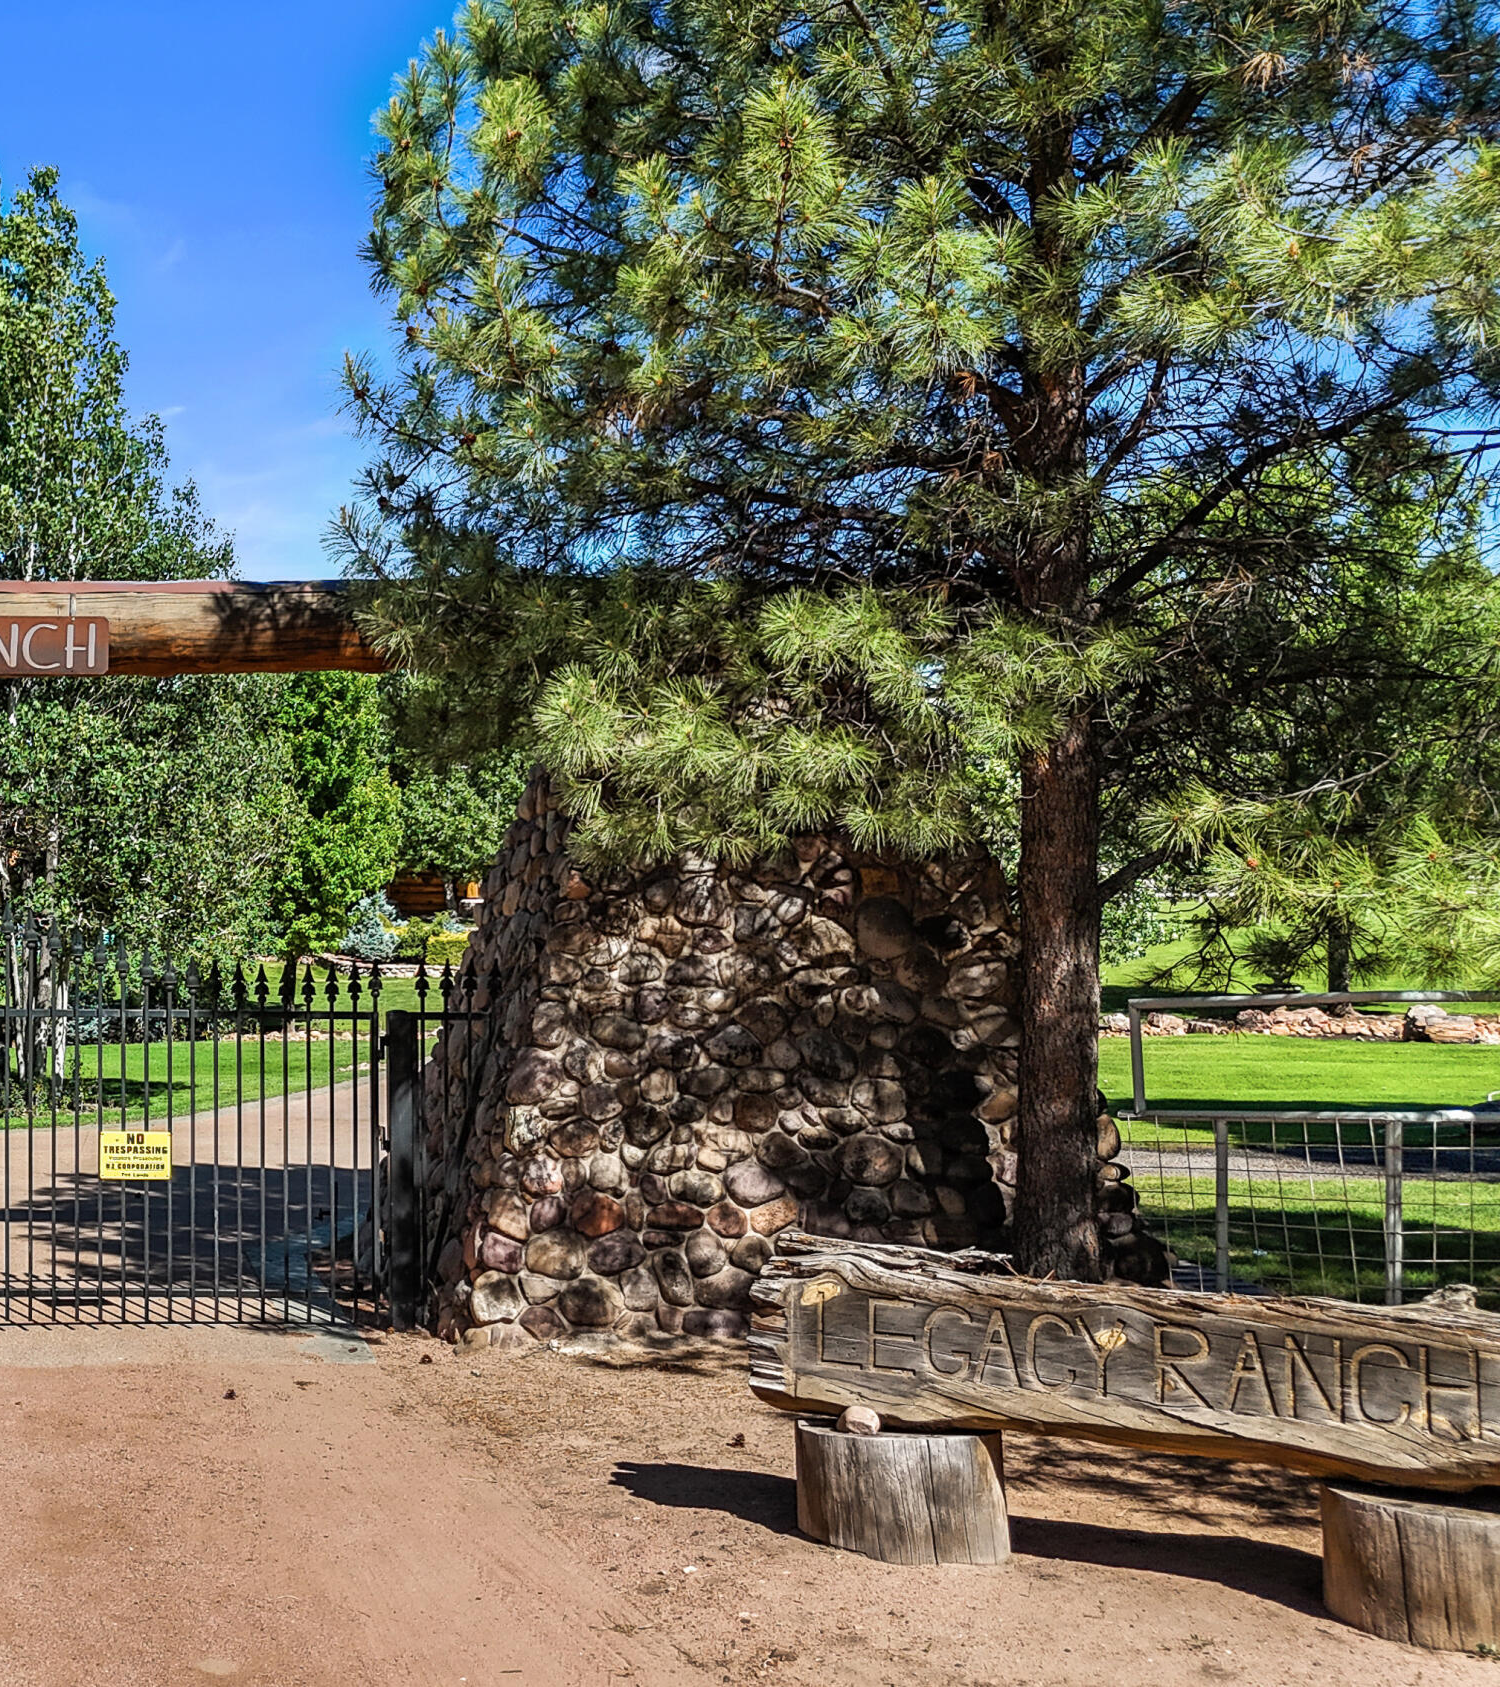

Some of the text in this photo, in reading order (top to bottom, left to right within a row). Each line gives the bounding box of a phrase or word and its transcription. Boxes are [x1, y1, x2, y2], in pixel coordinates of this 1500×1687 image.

[127, 1133, 144, 1144] NO
[104, 1146, 168, 1154] TRESPASSING
[816, 1291, 1484, 1442] LEGACY RANCH
